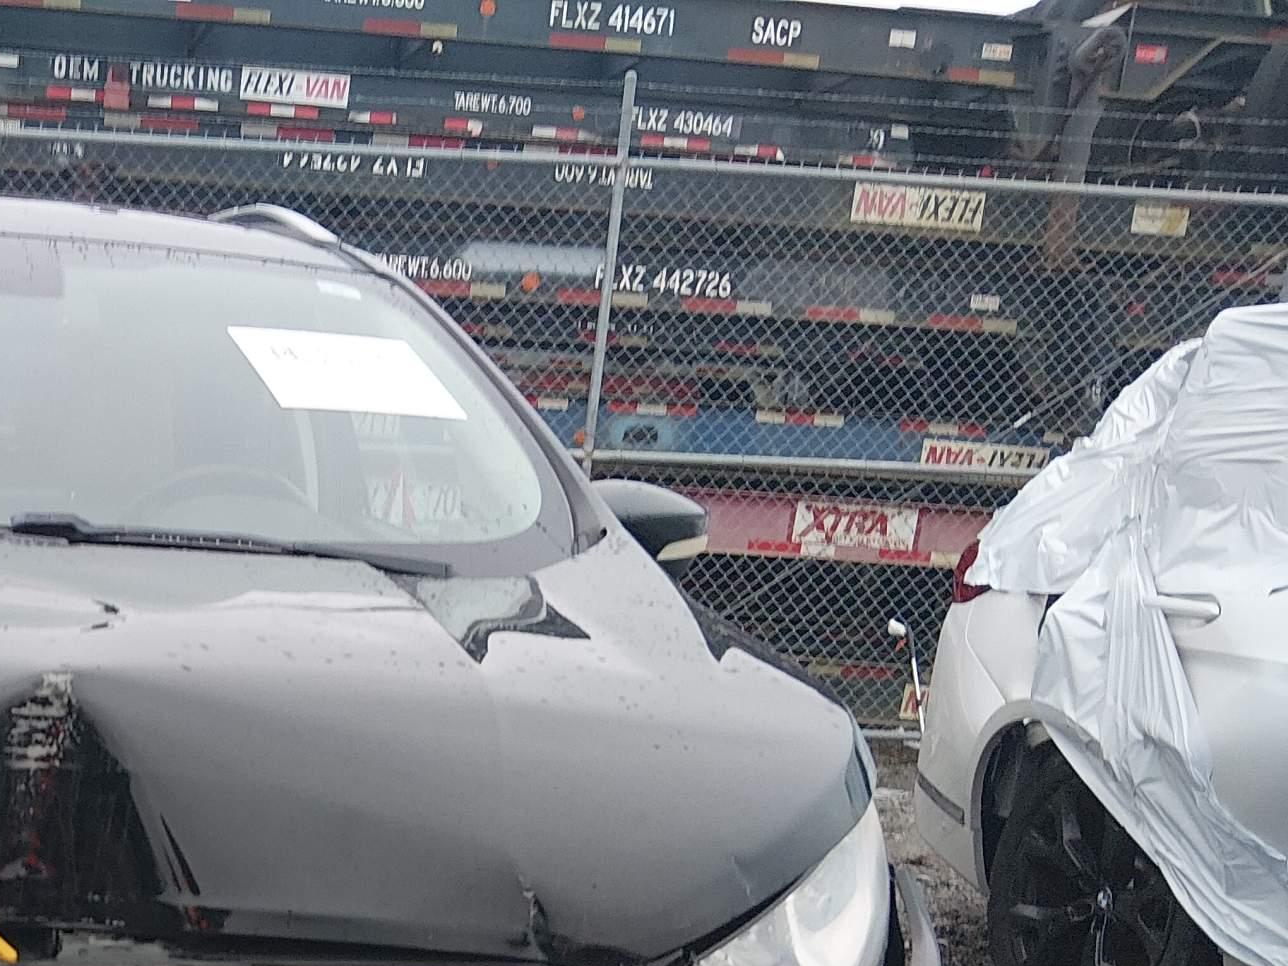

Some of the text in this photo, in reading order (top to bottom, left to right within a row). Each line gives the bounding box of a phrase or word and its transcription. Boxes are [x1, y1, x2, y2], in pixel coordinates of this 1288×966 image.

[549, 0, 675, 37] FLXZ 414671
[751, 16, 802, 47] SACP
[53, 53, 233, 93] OEM TRUCKING
[673, 110, 734, 137] 430464
[652, 266, 732, 299] 442726
[799, 503, 888, 543] XTRA
